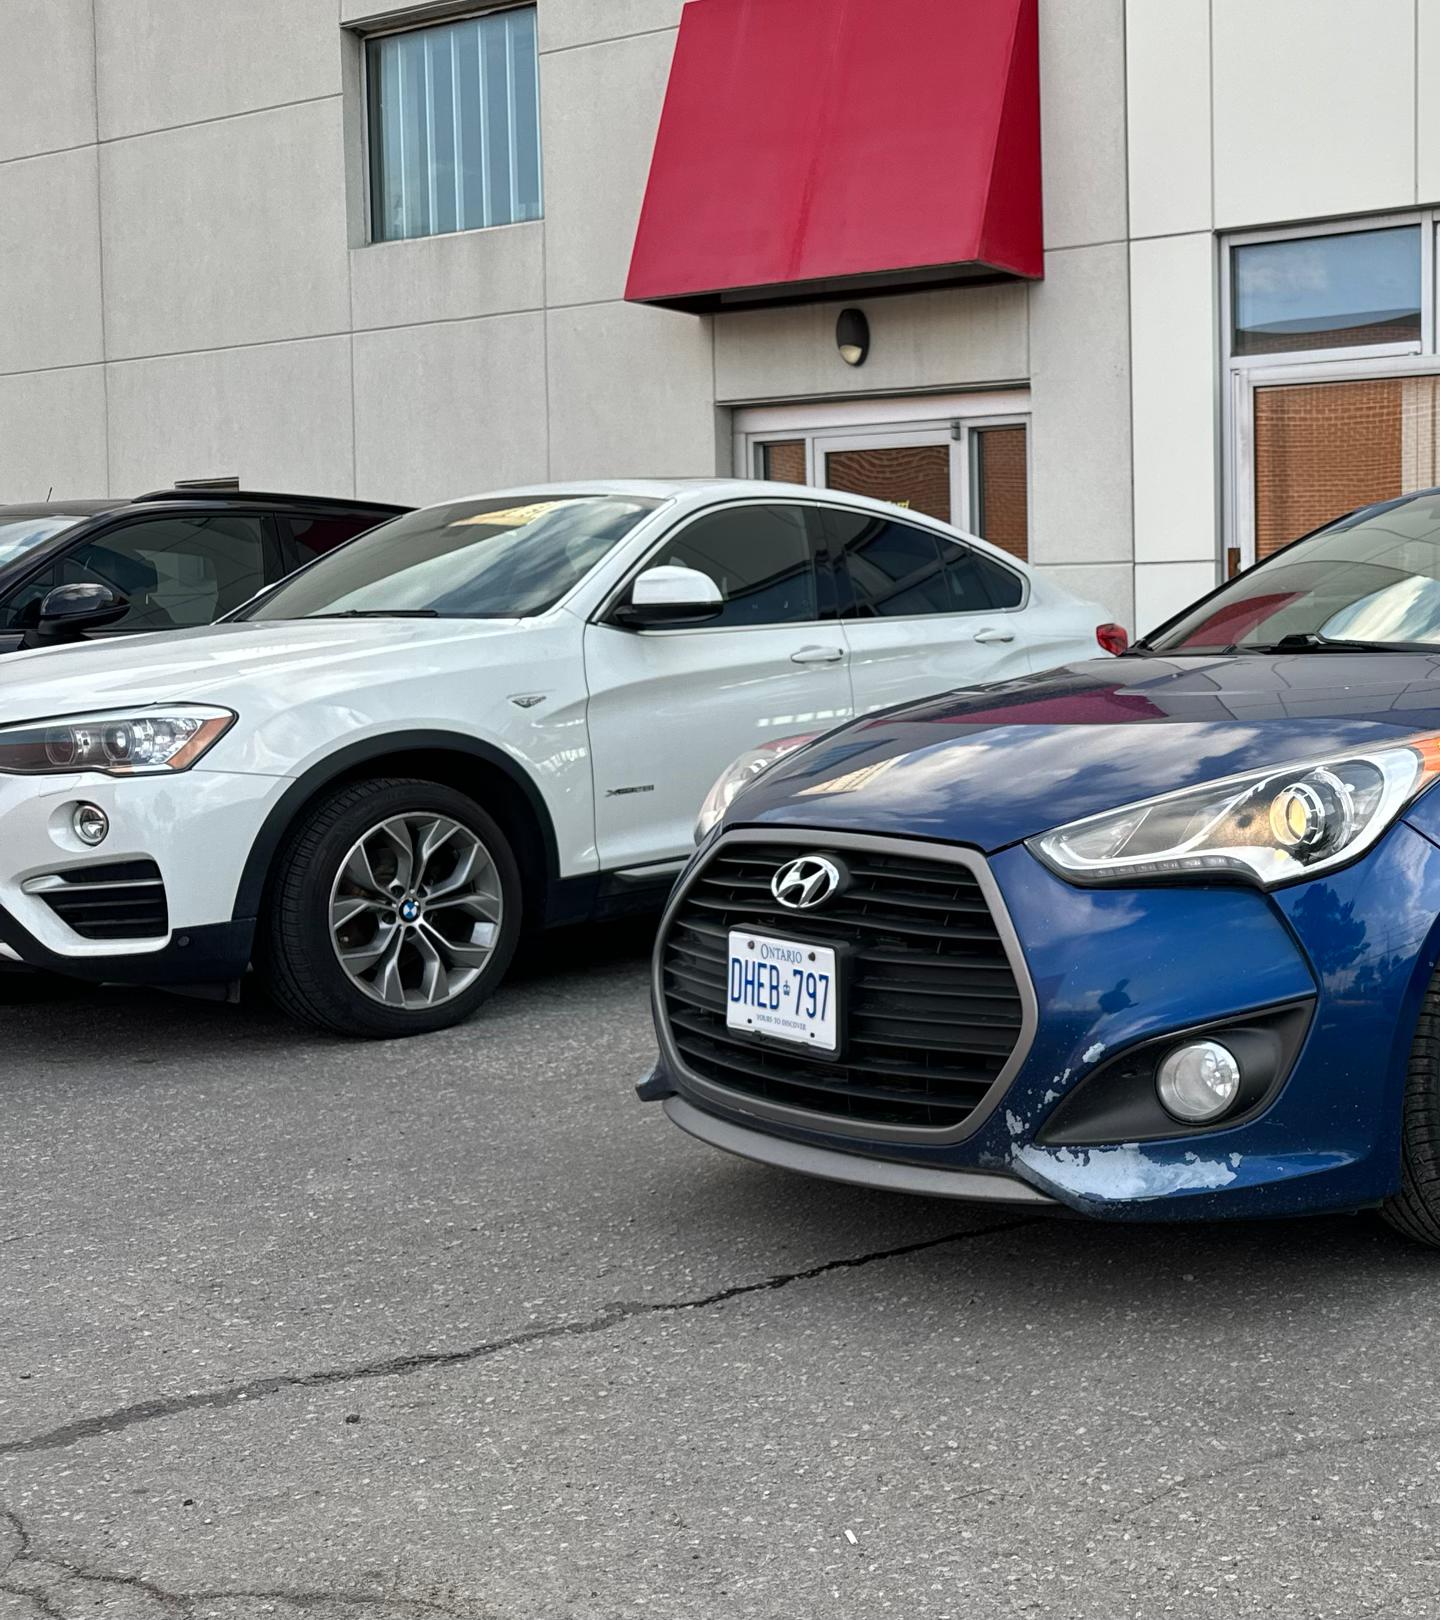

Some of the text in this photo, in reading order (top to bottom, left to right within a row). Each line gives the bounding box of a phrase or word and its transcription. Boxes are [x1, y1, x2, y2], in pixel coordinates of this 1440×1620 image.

[761, 943, 803, 965] ONTARIO
[730, 957, 830, 1021] DHEB 797
[756, 1014, 773, 1023] YOURS
[774, 1017, 782, 1025] TO
